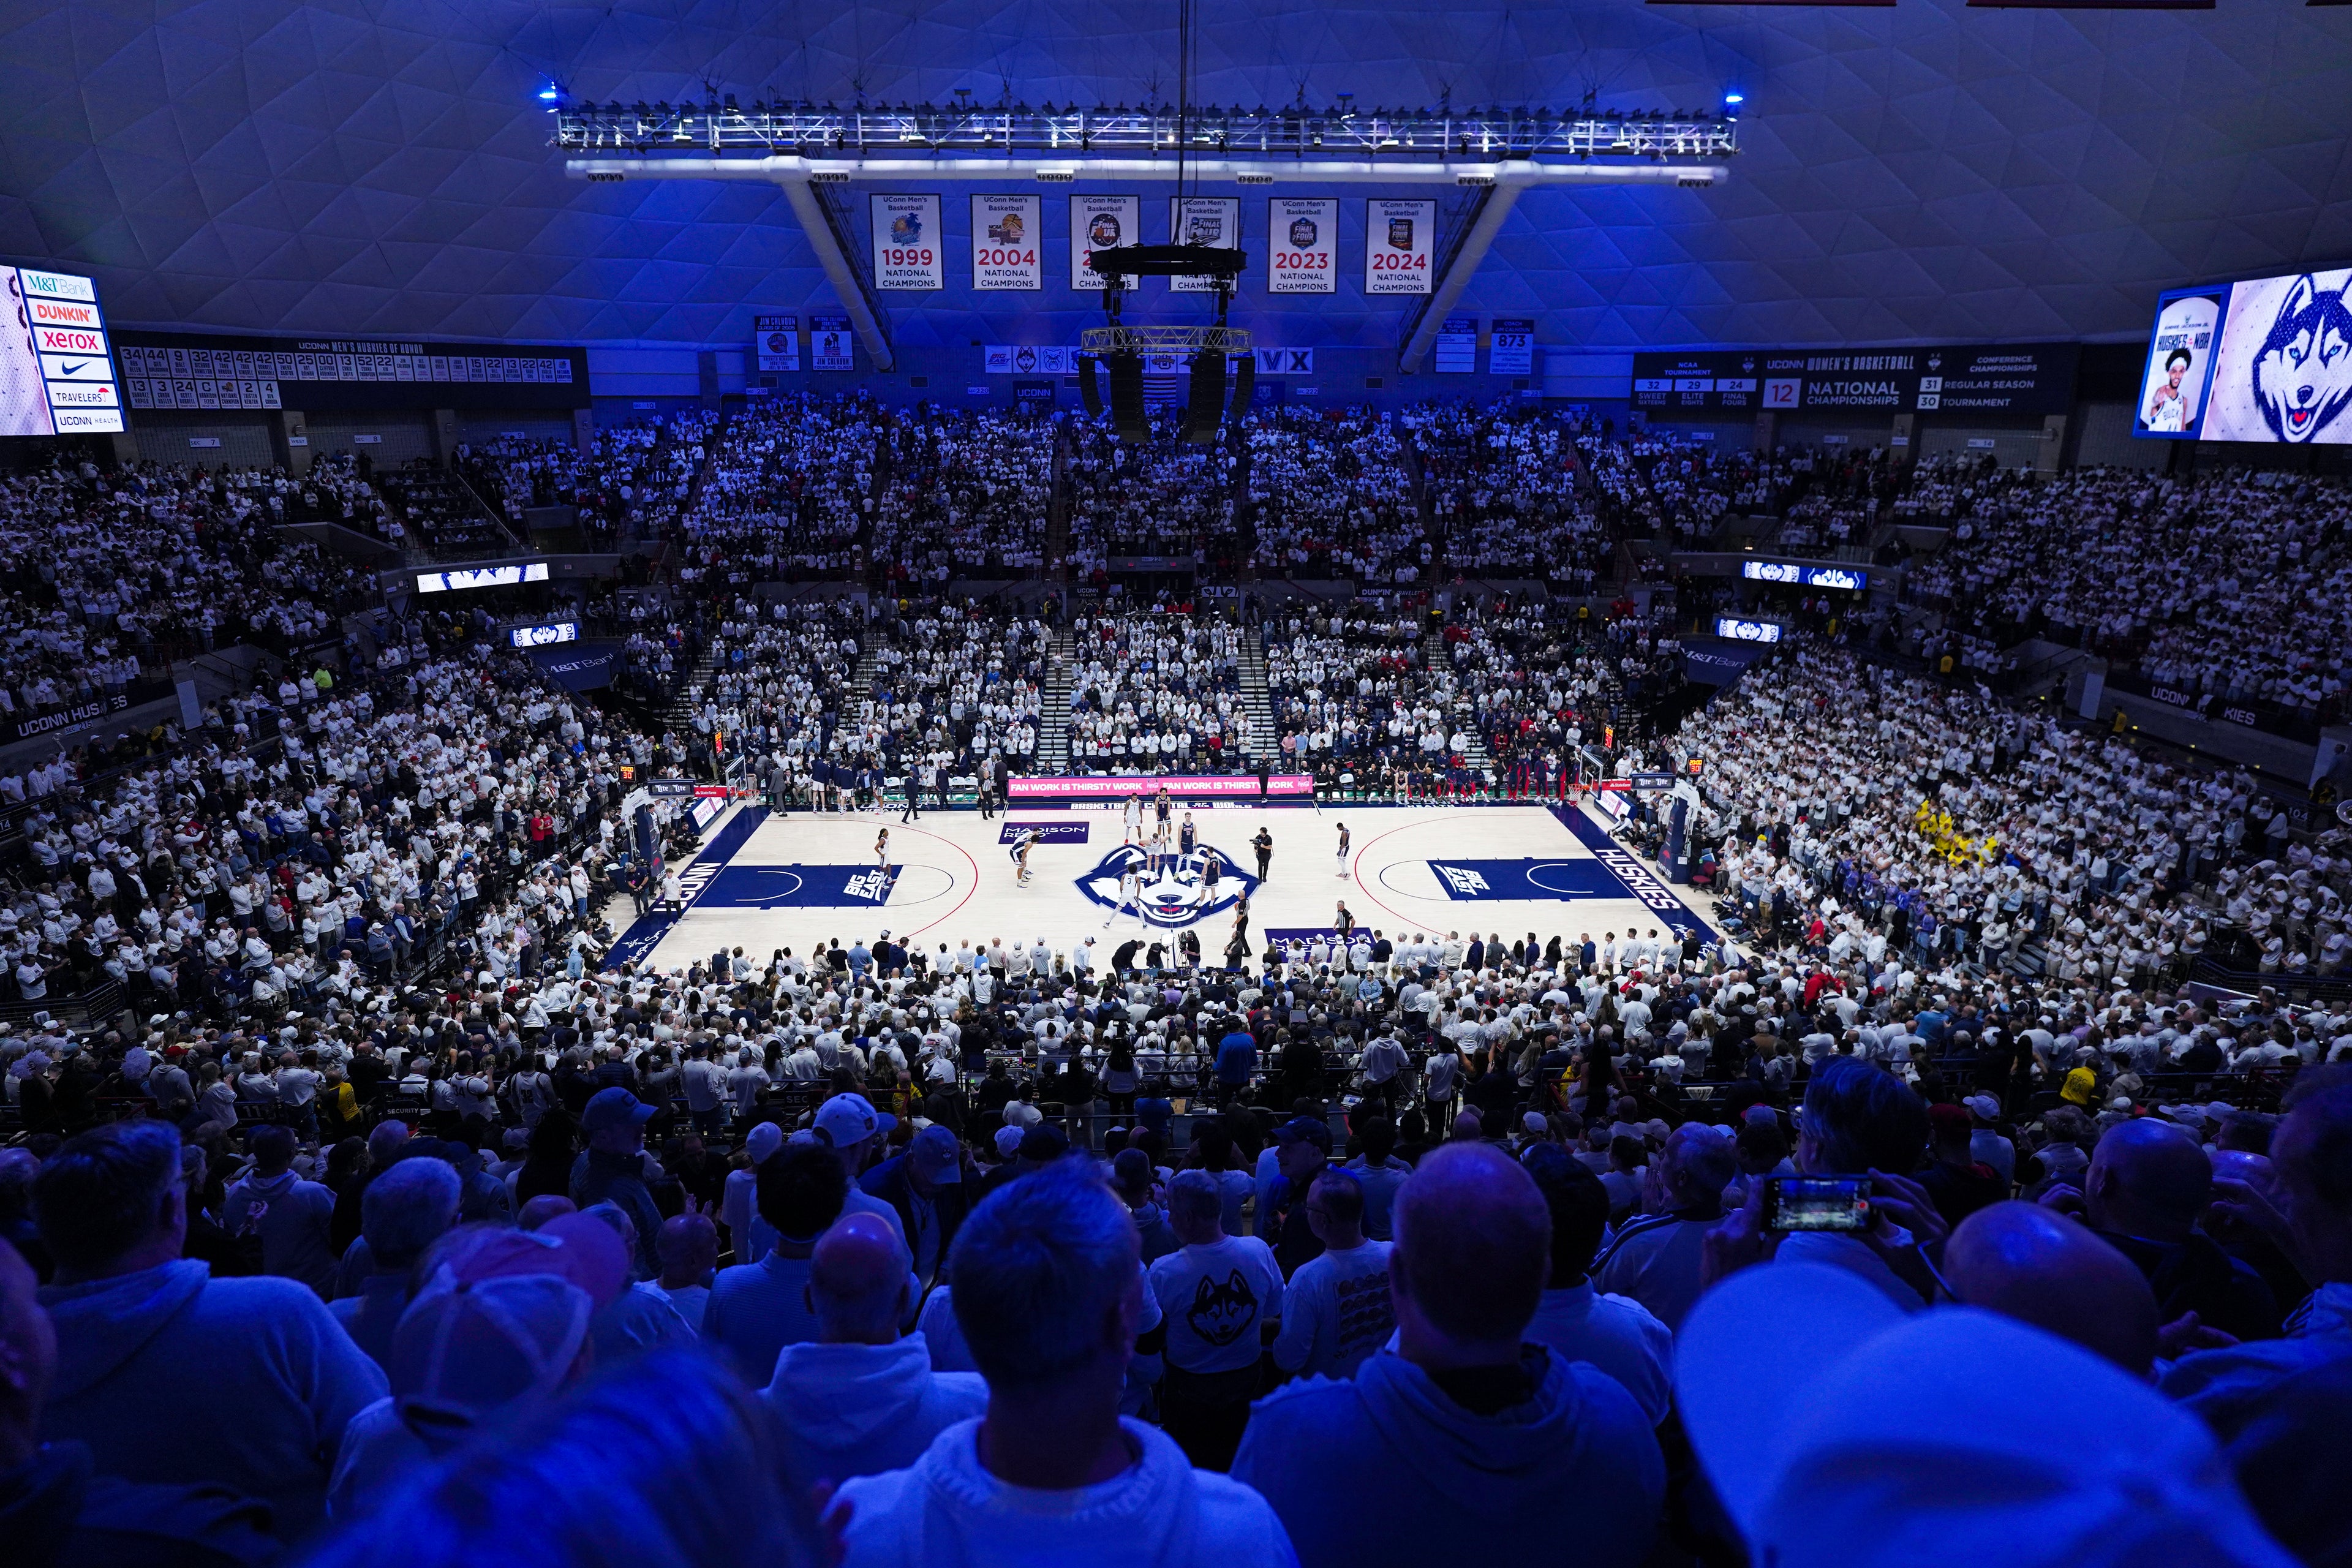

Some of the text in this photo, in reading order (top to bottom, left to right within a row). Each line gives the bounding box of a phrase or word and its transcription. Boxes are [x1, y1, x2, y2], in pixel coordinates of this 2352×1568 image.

[882, 249, 933, 266] 1999
[978, 249, 1036, 266] 2004
[1275, 252, 1328, 269] 2023
[1372, 254, 1427, 270] 2024
[28, 275, 88, 296] M&T Bank
[37, 304, 90, 322] DUNKIN'
[43, 331, 99, 350] xerox
[1498, 334, 1526, 347] 873
[2157, 334, 2188, 351] HUSKIES
[2193, 332, 2210, 350] NBA
[331, 342, 355, 353] MEN'S
[356, 342, 388, 353] HUSKIES
[389, 343, 398, 353] OF
[400, 344, 423, 354] HONOR
[123, 349, 141, 360] 34
[147, 350, 165, 360] 44
[173, 350, 183, 361] 9
[192, 351, 209, 362] 32
[214, 352, 230, 362] 42
[236, 353, 251, 363] 42
[257, 353, 272, 364] 42
[277, 355, 292, 364] 50
[298, 355, 314, 365] 25
[319, 355, 333, 365] 00
[1977, 355, 2033, 364] CONFERENCE
[341, 356, 351, 365] 13
[358, 356, 372, 366] 52
[377, 356, 392, 366] 22
[471, 359, 481, 368] 15
[487, 359, 501, 368] 22
[507, 360, 516, 368] 13
[522, 360, 536, 369] 22
[540, 360, 552, 369] 42
[1261, 350, 1283, 371] V
[1288, 351, 1309, 371] X
[1766, 355, 1914, 371] UCONN WOMEN'S BASKETBALL
[1969, 364, 2038, 372] CHAMPIONSHIPS
[132, 380, 146, 391] 13
[158, 381, 167, 392] 3
[175, 382, 194, 392] 24
[202, 382, 211, 392] C
[244, 382, 253, 393] 2
[265, 383, 273, 393] 4
[1808, 381, 1900, 395] NATIONAL
[1925, 380, 2035, 389] 31 REGULAR SEASON
[56, 393, 102, 402] TRAVELERS
[1017, 388, 1050, 397] UCONN
[1772, 385, 1793, 402] 12
[1806, 396, 1899, 405] CHAMPIONSHIPS
[1921, 398, 2011, 407] 30 TOURNAMENT
[60, 417, 92, 425] UCONN
[17, 710, 69, 737] UCONN
[80, 721, 92, 730] 215
[655, 784, 686, 793] Lite Lite
[2288, 807, 2308, 821] 104
[1656, 859, 1672, 878] TRAVELERS
[843, 874, 867, 895] BIG
[858, 869, 881, 899] EAST
[1444, 865, 1478, 895] EAST
[1460, 869, 1491, 890] BIG
[1594, 849, 1681, 910] HUSKIES
[452, 1084, 466, 1098] 34
[521, 1089, 534, 1104] 32
